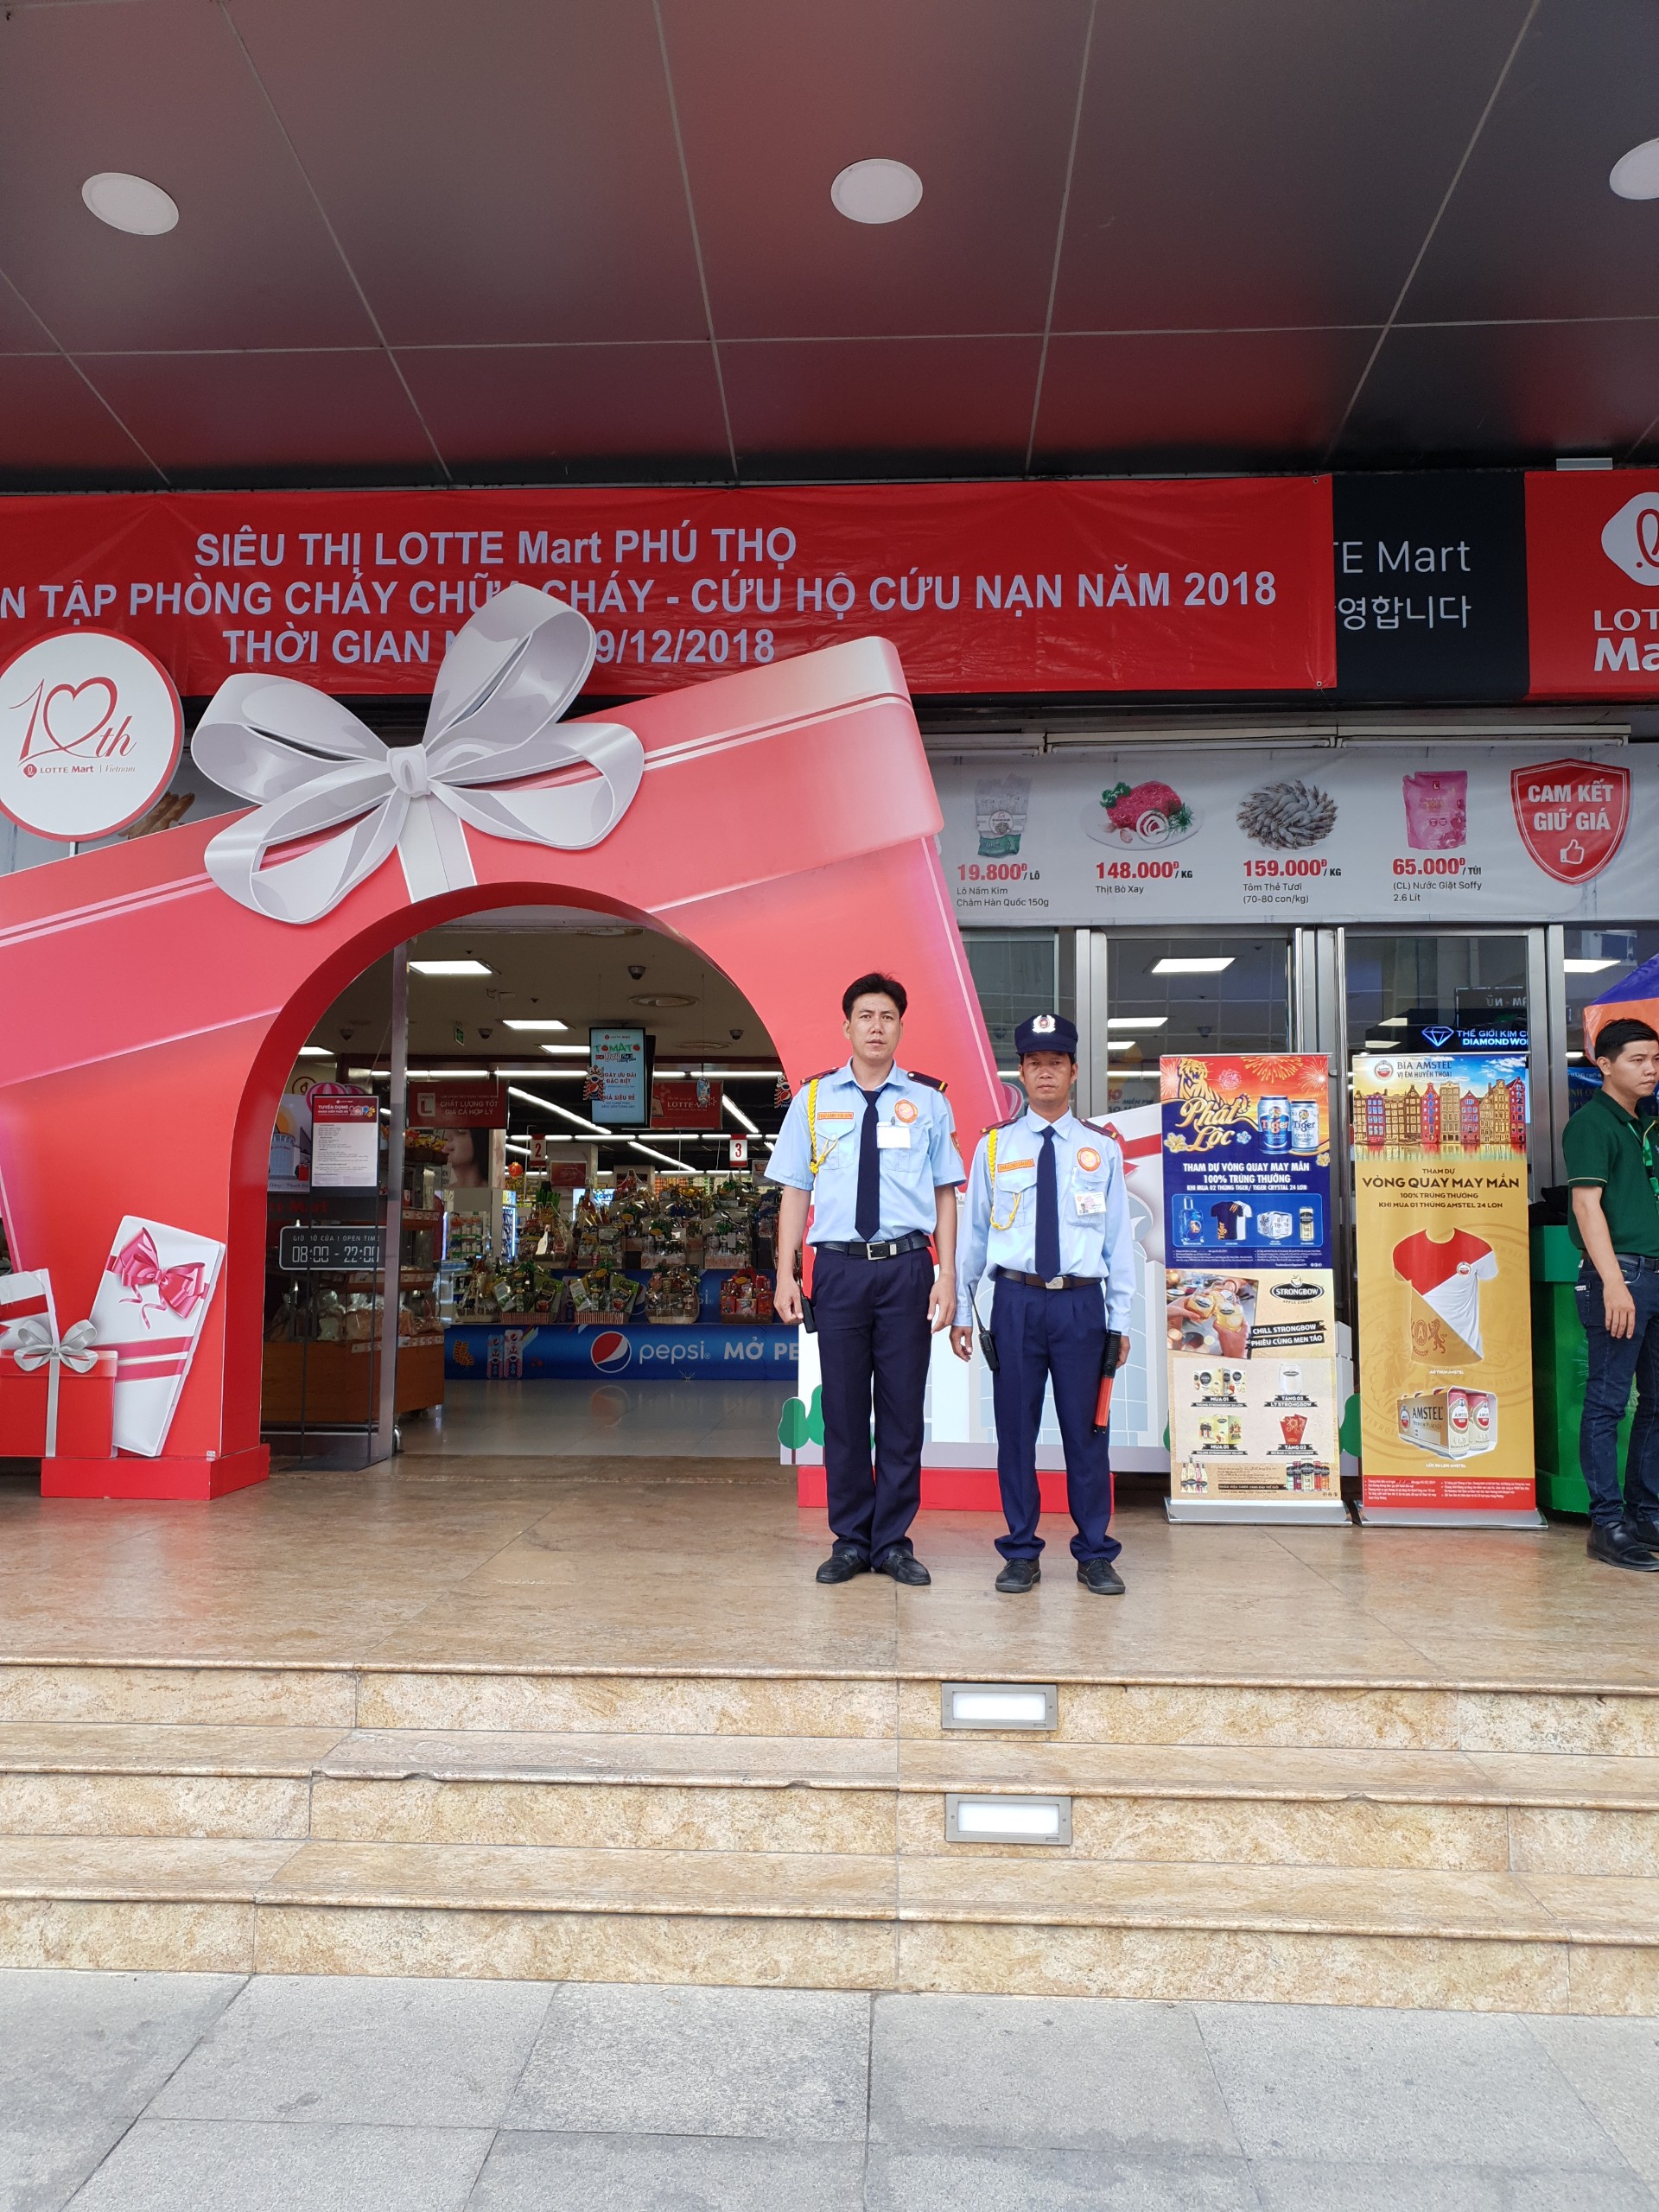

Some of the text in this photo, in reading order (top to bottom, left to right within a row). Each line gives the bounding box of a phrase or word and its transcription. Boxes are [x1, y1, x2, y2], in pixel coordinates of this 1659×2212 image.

[194, 520, 797, 572] SIÊU THỊ LOTTE Mart PHÚ THỌ
[1378, 541, 1471, 573] Mart
[39, 580, 117, 626] TẬP
[130, 573, 271, 615] PHÒNG
[410, 572, 519, 613] CHỮ
[691, 569, 780, 613] CỨU
[795, 571, 855, 620] HỘ
[869, 567, 960, 610] CỨU
[976, 574, 1063, 617] NẠN
[1077, 563, 1170, 607] NĂM
[1184, 571, 1277, 606] 2018
[1334, 595, 1472, 631] 영합니다
[222, 622, 318, 664] THỜI
[332, 630, 430, 664] GIAN
[71, 765, 94, 773] Mart
[1528, 779, 1614, 803] CAM KẾT
[1534, 807, 1611, 831] GIỮ GIÁ
[1181, 870, 1193, 879] KG
[1329, 868, 1342, 877] KG
[991, 887, 1008, 895] Kim
[1096, 884, 1144, 895] Thịt Bò Xay
[1243, 882, 1262, 892] Tôm
[1282, 881, 1303, 891] Tươi
[1393, 880, 1483, 892] (CL) Nước Giặt Soffy
[957, 896, 1049, 909] Châm Hàn Quốc 150g
[1243, 893, 1310, 905] (70-80 con/kg)
[1394, 893, 1421, 902] 2.6 Lít
[1478, 1027, 1497, 1038] GIỚI
[1500, 1029, 1517, 1038] KIM
[1397, 1061, 1452, 1070] BIA AMSTEL
[1175, 1096, 1243, 1152] Phát Lộc
[1293, 1120, 1316, 1133] Tiger
[535, 1143, 542, 1157] 2
[734, 1143, 742, 1158] 3
[1183, 1163, 1207, 1172] THAM
[1222, 1161, 1245, 1172] VÒNG
[1246, 1163, 1268, 1172] QUAY
[1270, 1163, 1289, 1172] MAY
[1204, 1172, 1292, 1184] 100% TRÚNG THƯỞNG
[1362, 1172, 1520, 1189] VÒNG QUAY MAY MẮN
[1420, 1191, 1446, 1199] TRÚNG
[1420, 1200, 1446, 1209] THÙNG
[292, 1245, 379, 1263] 08:00 22:00
[1275, 1287, 1319, 1296] STRONGBOW
[1273, 1324, 1317, 1333] STRONGBOW
[1272, 1337, 1293, 1345] CÙNG
[1309, 1333, 1324, 1343] TÁO
[639, 1340, 705, 1364] pepsi
[724, 1337, 765, 1360] MỞ
[1412, 1406, 1444, 1421] AMSTEL
